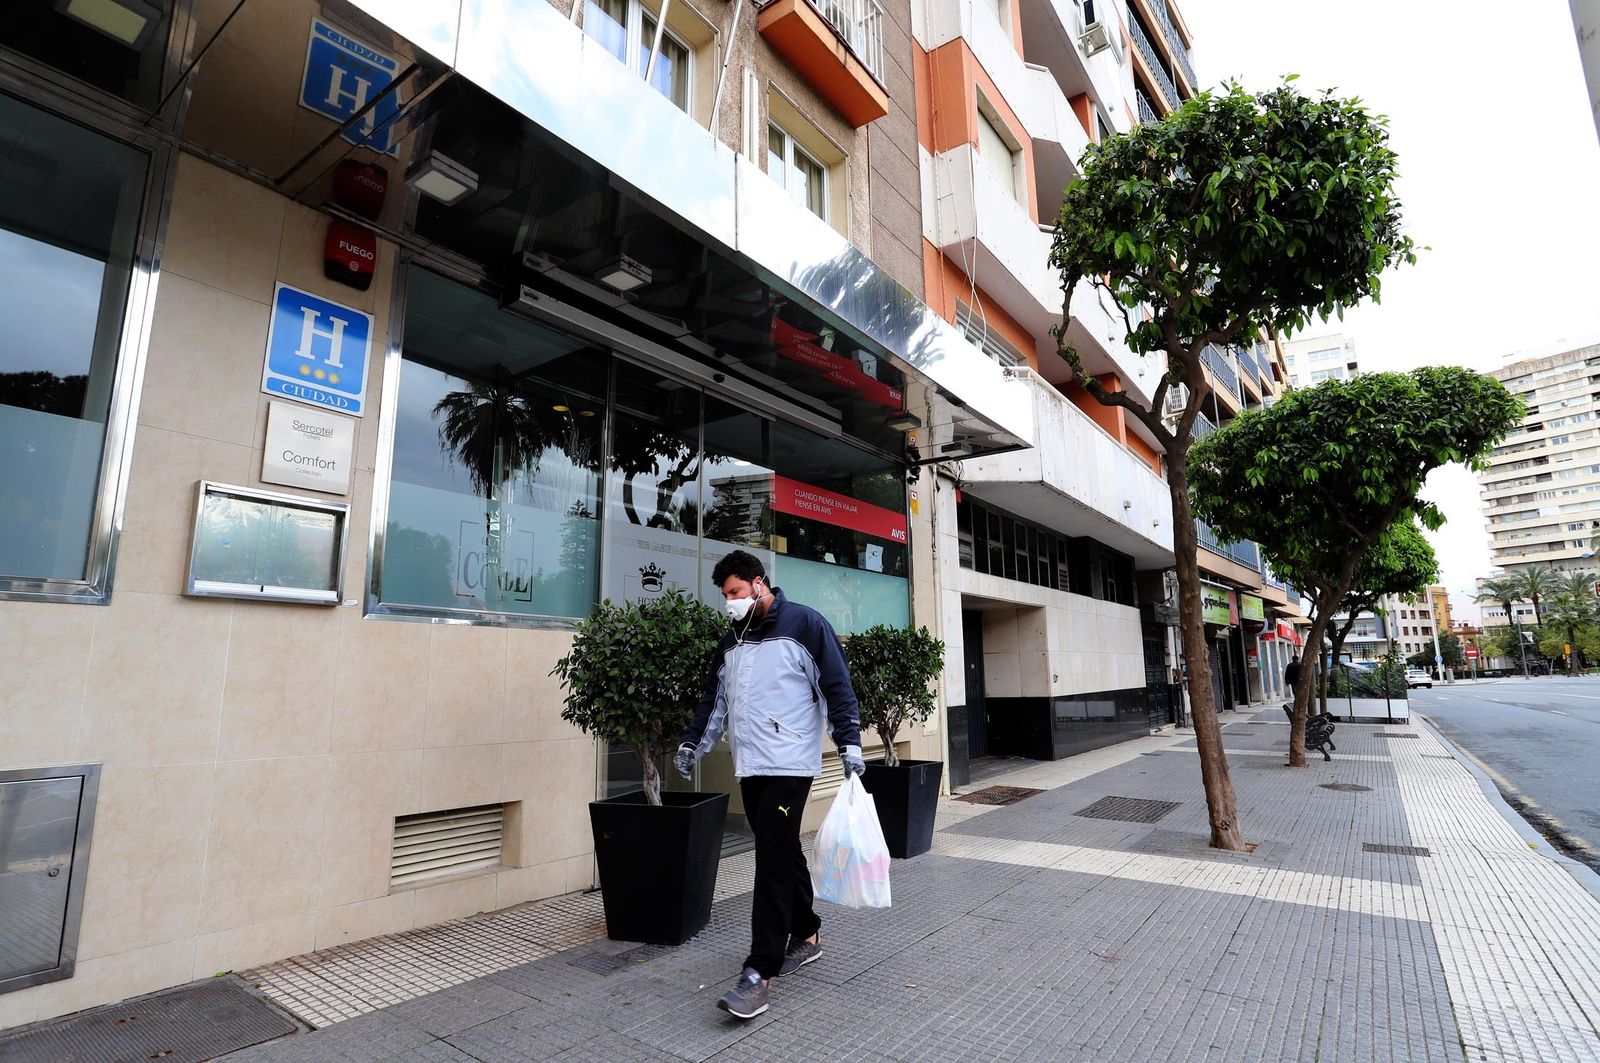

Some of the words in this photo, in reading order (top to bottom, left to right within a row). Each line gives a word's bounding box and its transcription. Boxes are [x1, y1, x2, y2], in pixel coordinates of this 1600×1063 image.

[339, 240, 374, 260] FUEGO
[294, 306, 349, 369] H
[281, 382, 349, 408] CIUDAD
[291, 419, 334, 437] Sercotel
[303, 432, 321, 441] hotels
[282, 450, 336, 471] Comfort
[295, 467, 322, 478] Collection
[794, 489, 817, 502] CUANDO
[818, 496, 836, 507] PIENSE
[835, 500, 842, 508] EN
[794, 498, 813, 511] PIENSE
[813, 504, 821, 512] EN
[821, 506, 832, 515] AVIS
[891, 528, 905, 540] AVIS
